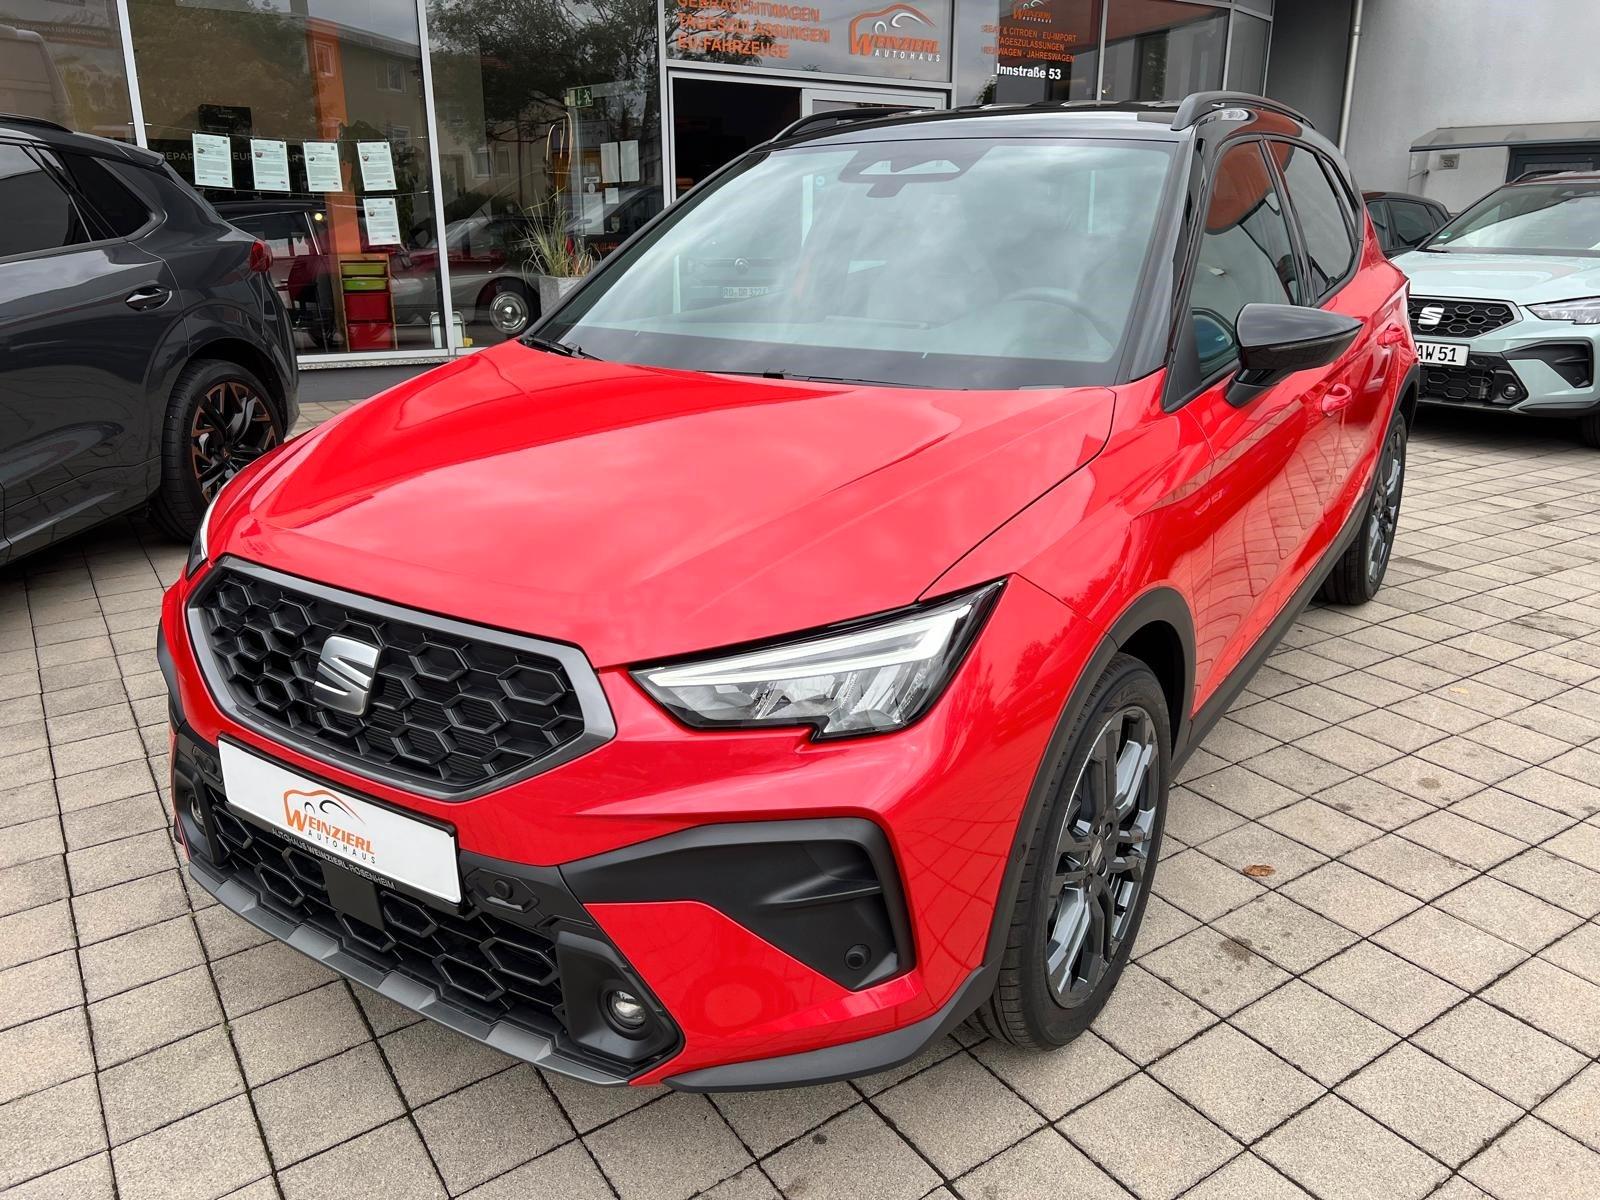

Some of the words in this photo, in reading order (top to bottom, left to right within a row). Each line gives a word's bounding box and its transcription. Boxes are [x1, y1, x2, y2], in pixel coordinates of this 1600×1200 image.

[849, 33, 941, 56] WEINZIERL
[996, 36, 1065, 51] TAGESZULASSUNGEN
[873, 49, 941, 63] AUTOHAUS
[1026, 50, 1075, 63] JAHRESWAGEN
[996, 63, 1047, 79] Innstraße
[1048, 68, 1062, 80] 53
[1438, 346, 1457, 362] 51
[286, 808, 375, 855] WEINZIERL
[308, 829, 376, 865] AUTOHAUS
[271, 827, 307, 851] AUTOHAUS
[306, 845, 349, 870] WEINZIERL
[349, 864, 396, 890] ROSENHEIM
